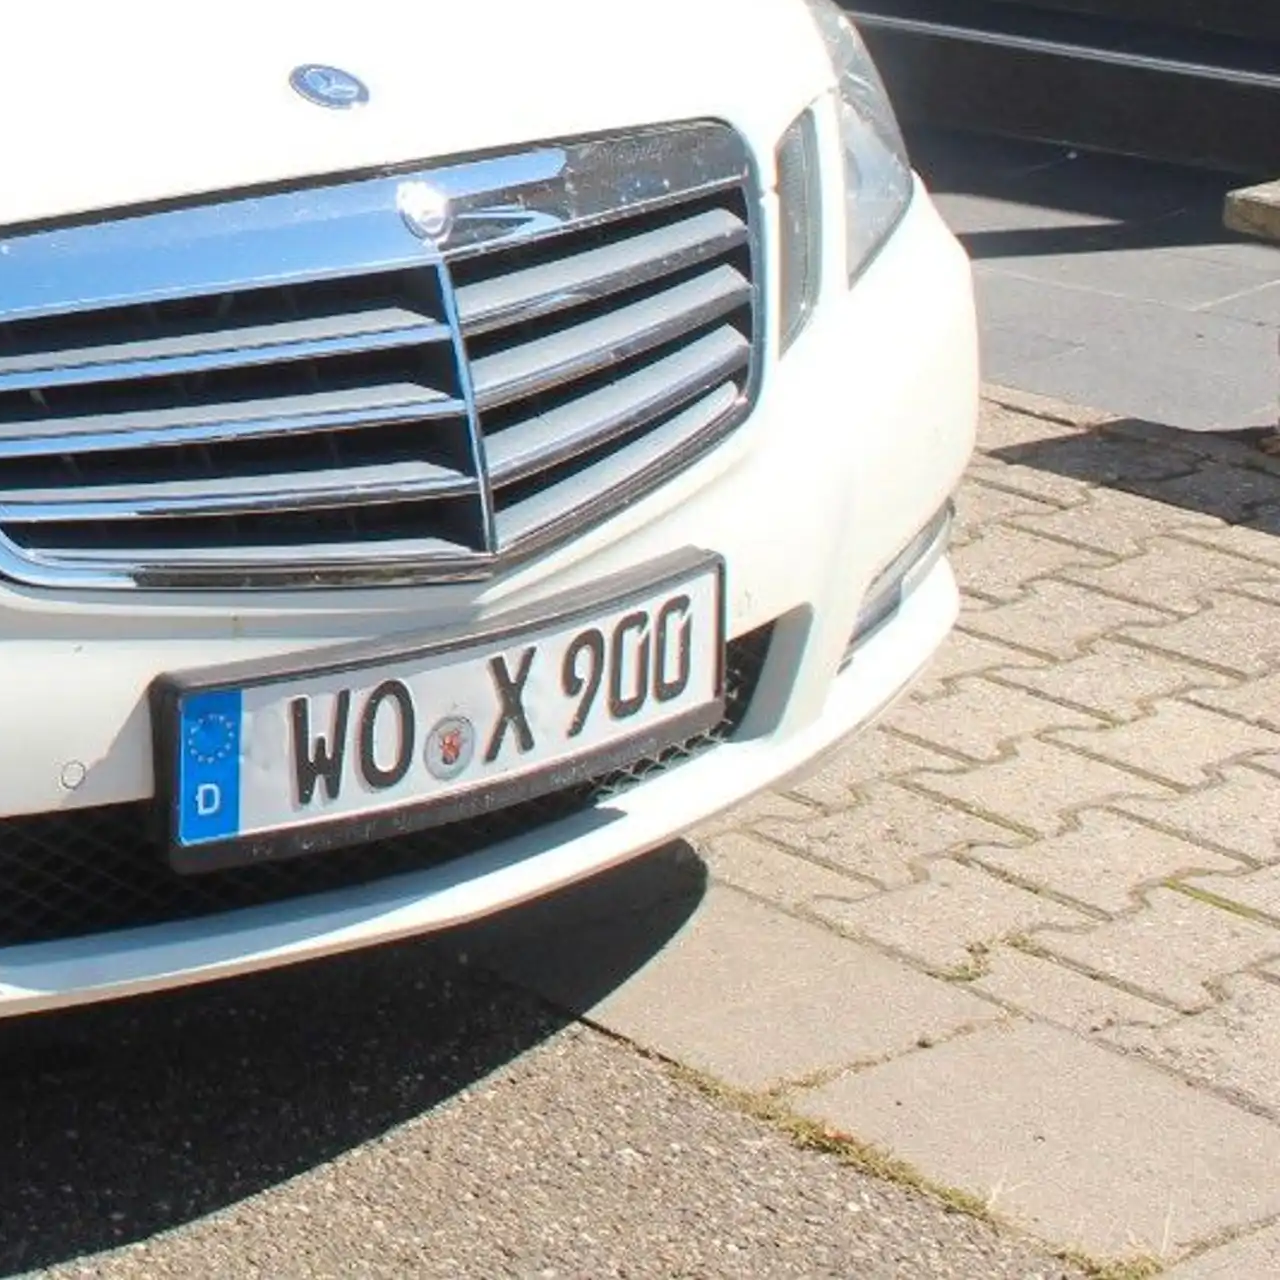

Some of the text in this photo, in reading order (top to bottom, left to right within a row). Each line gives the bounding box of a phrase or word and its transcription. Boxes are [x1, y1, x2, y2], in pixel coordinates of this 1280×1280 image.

[289, 593, 691, 806] WO X 900
[195, 784, 221, 815] D
